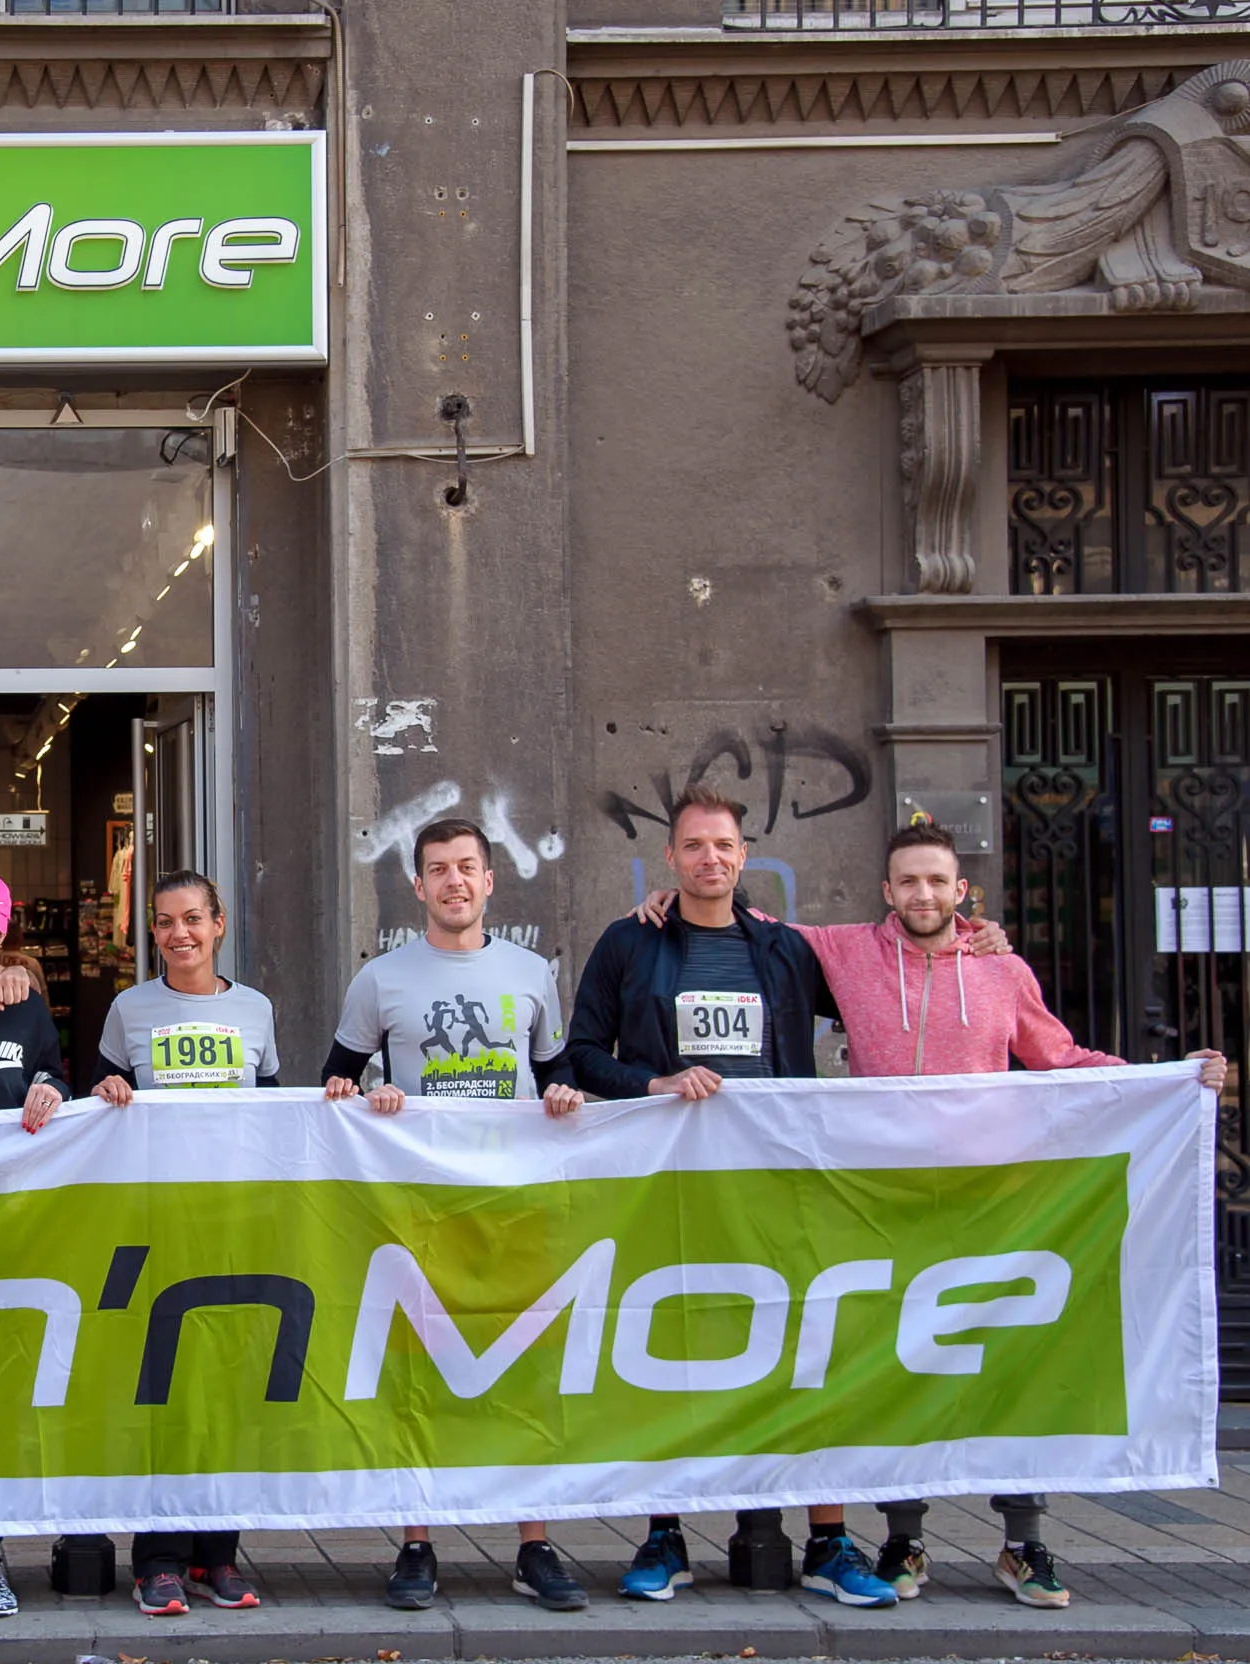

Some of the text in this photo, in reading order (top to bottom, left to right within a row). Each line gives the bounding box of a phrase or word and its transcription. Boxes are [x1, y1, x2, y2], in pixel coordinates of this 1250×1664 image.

[693, 1006, 750, 1038] 304
[157, 1035, 234, 1067] 1981
[691, 1044, 743, 1052] БЕОГРАДСКИХ
[166, 1071, 220, 1079] БЕОГРАДСКИХ
[426, 1079, 497, 1091] 2. БЕОГРАДСКИ
[343, 1237, 1072, 1401] More
